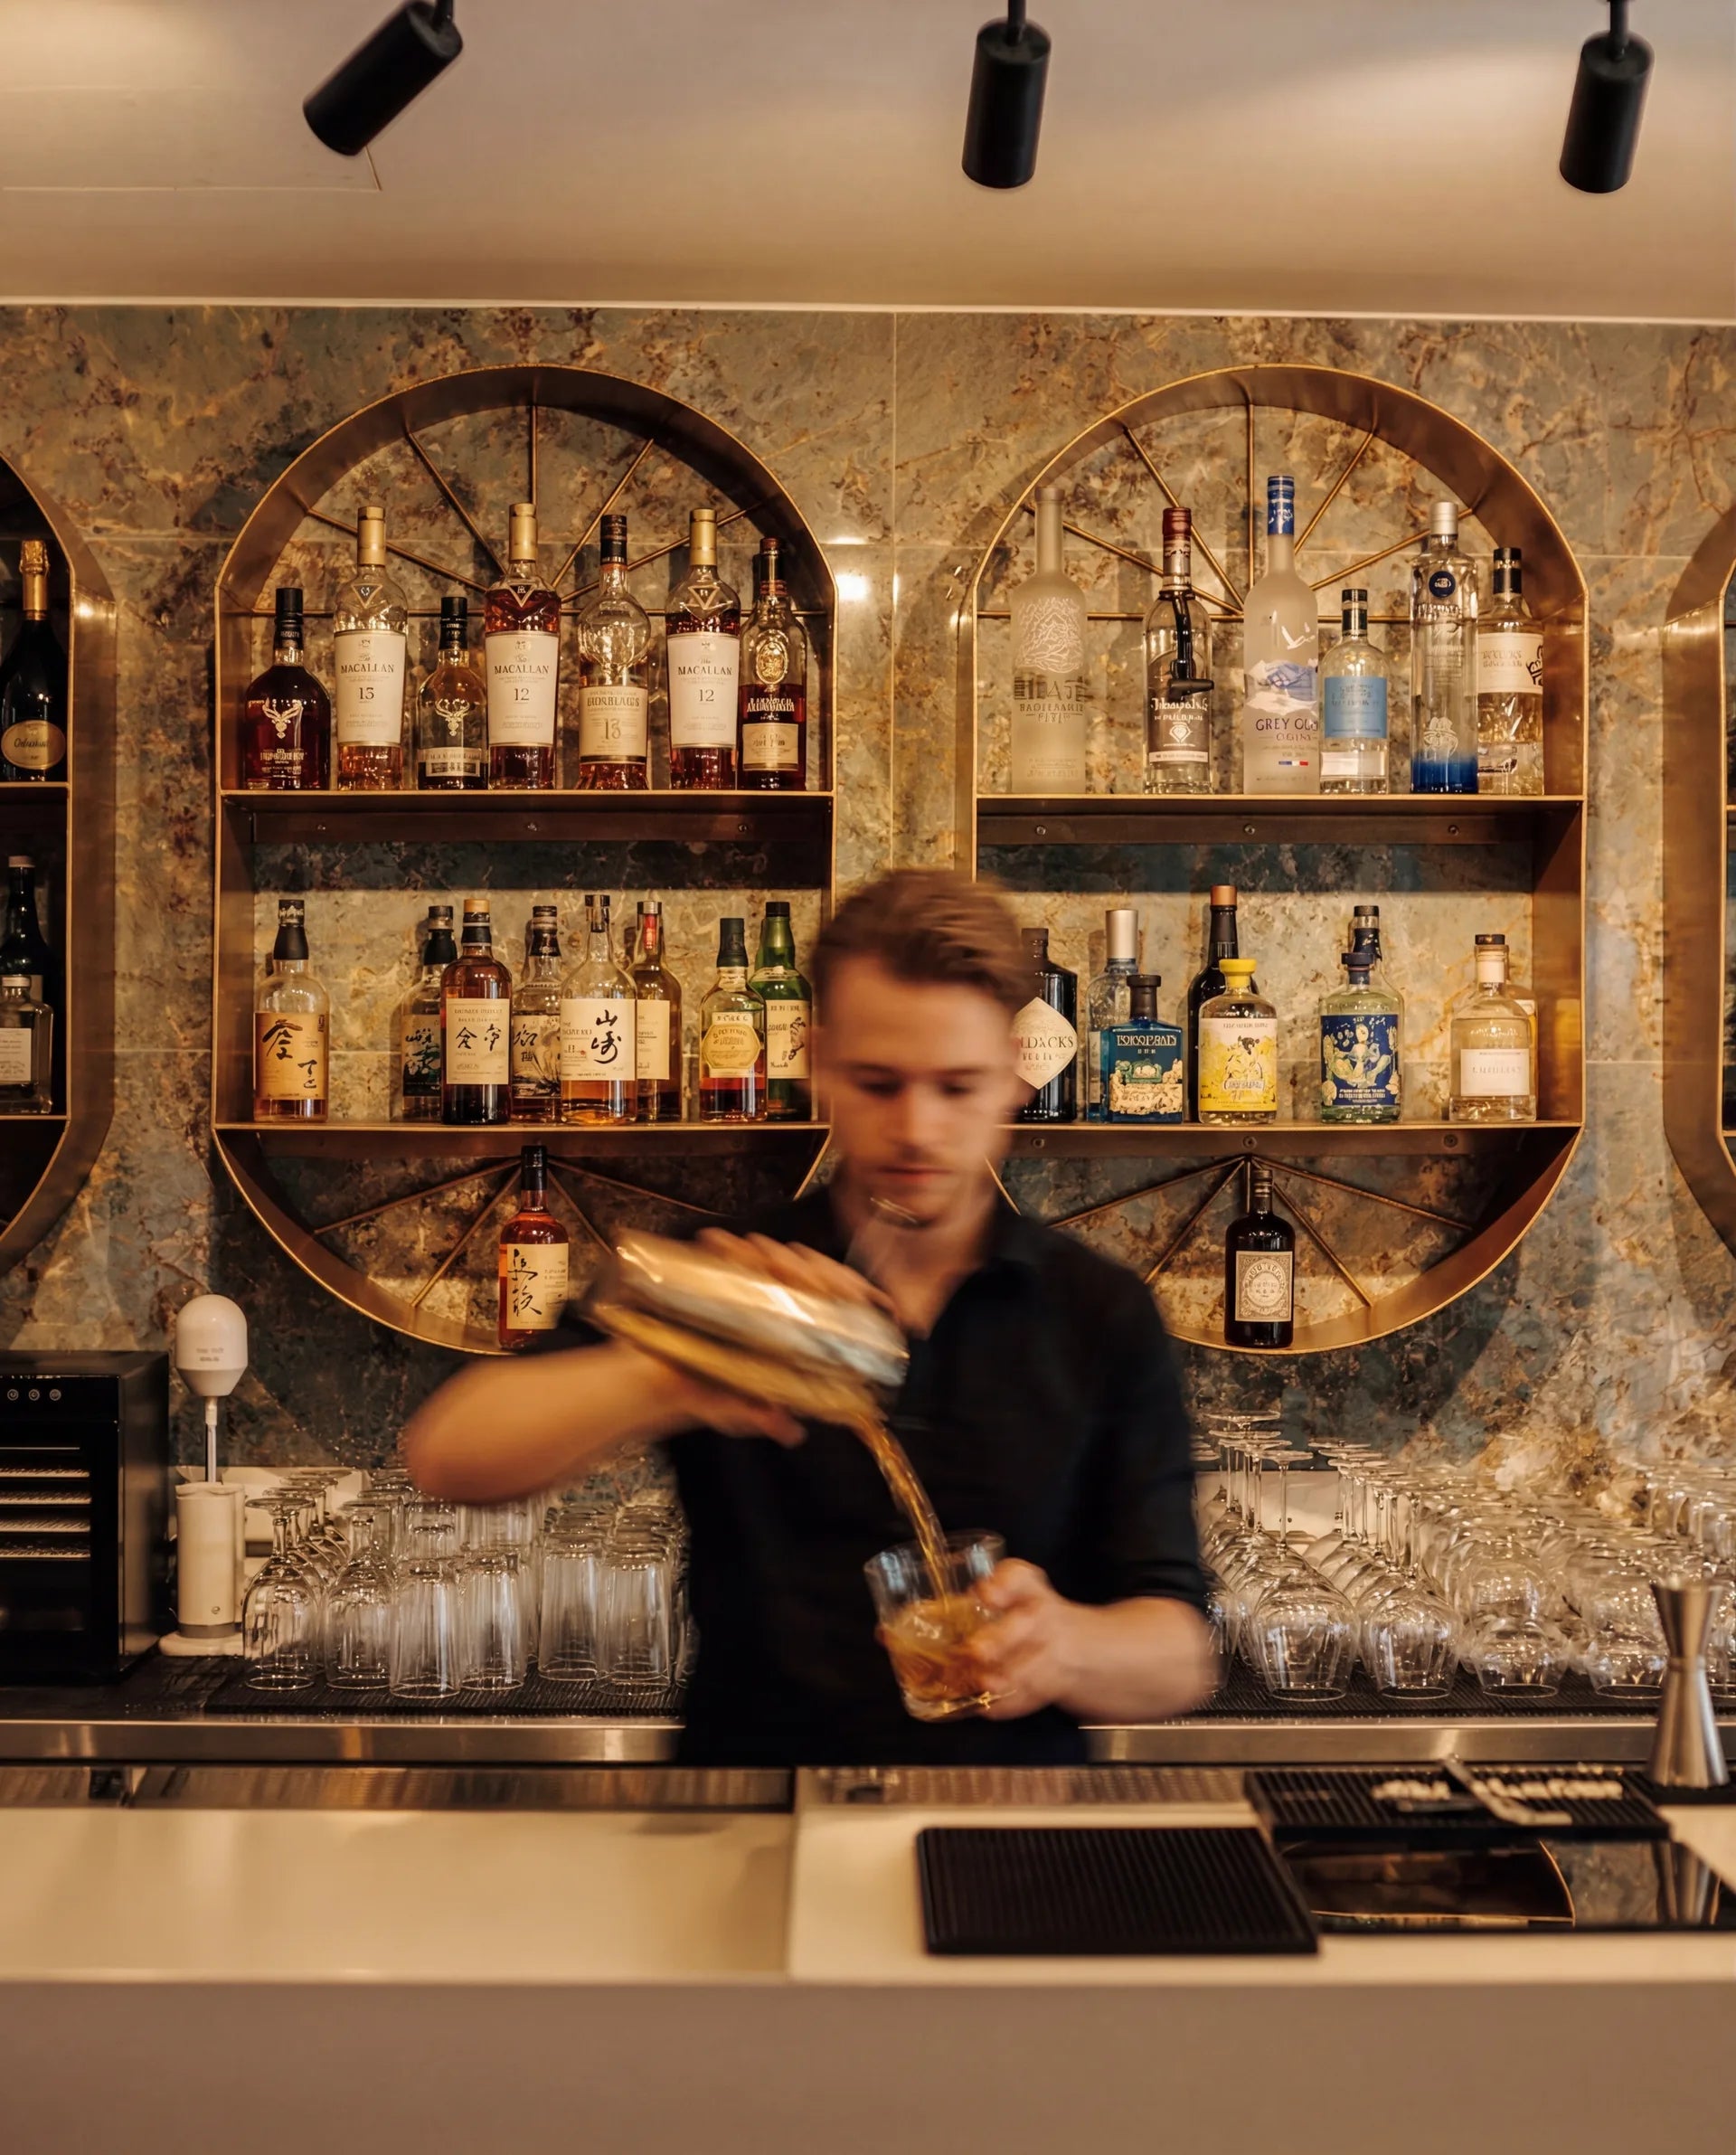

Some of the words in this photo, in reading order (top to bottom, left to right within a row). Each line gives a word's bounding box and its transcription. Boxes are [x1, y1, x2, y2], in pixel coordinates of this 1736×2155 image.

[341, 664, 394, 674] MACALLAN
[494, 665, 549, 674] MACALLAN
[677, 666, 732, 676] MACALLAN
[514, 688, 530, 701] 12
[699, 689, 714, 702] 12
[1256, 718, 1289, 731] GREY
